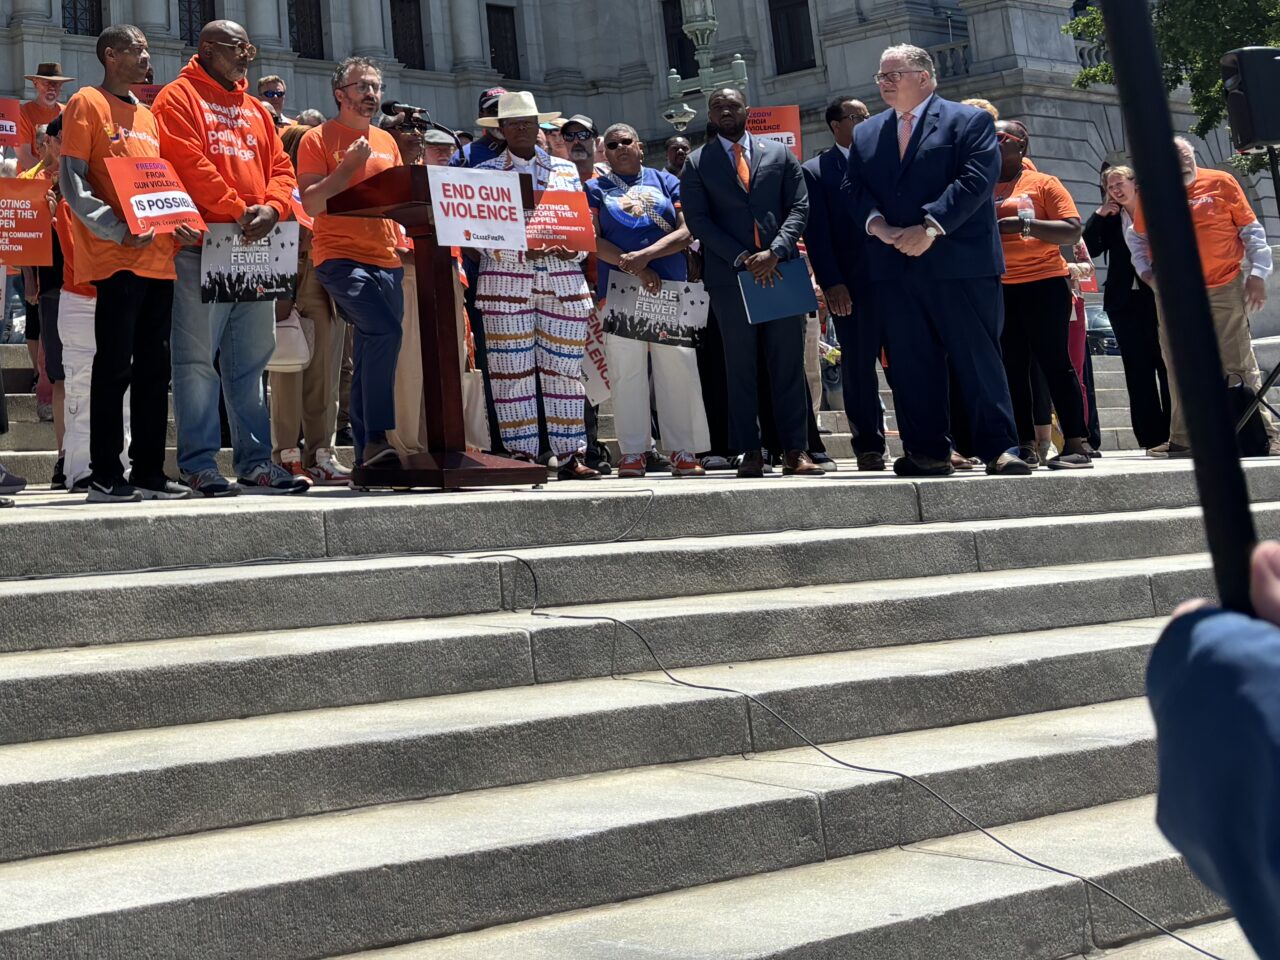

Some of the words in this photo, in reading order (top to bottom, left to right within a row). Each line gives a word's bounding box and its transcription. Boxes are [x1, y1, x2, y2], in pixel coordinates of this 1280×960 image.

[246, 134, 257, 146] &
[210, 143, 255, 161] change
[136, 163, 167, 171] FREEDOM
[145, 171, 166, 179] FROM
[134, 180, 150, 189] GUN
[441, 182, 475, 201] END
[478, 185, 512, 203] GUN
[135, 199, 146, 211] IS
[16, 210, 38, 219] THEY
[439, 201, 518, 222] VIOLENCE
[556, 210, 579, 218] THEY
[9, 231, 43, 239] COMMUNITY
[231, 252, 270, 264] FEWER
[231, 264, 270, 273] FUNERALS
[638, 285, 679, 301] MORE
[635, 300, 678, 316] FEWER
[634, 310, 676, 322] FUNERALS
